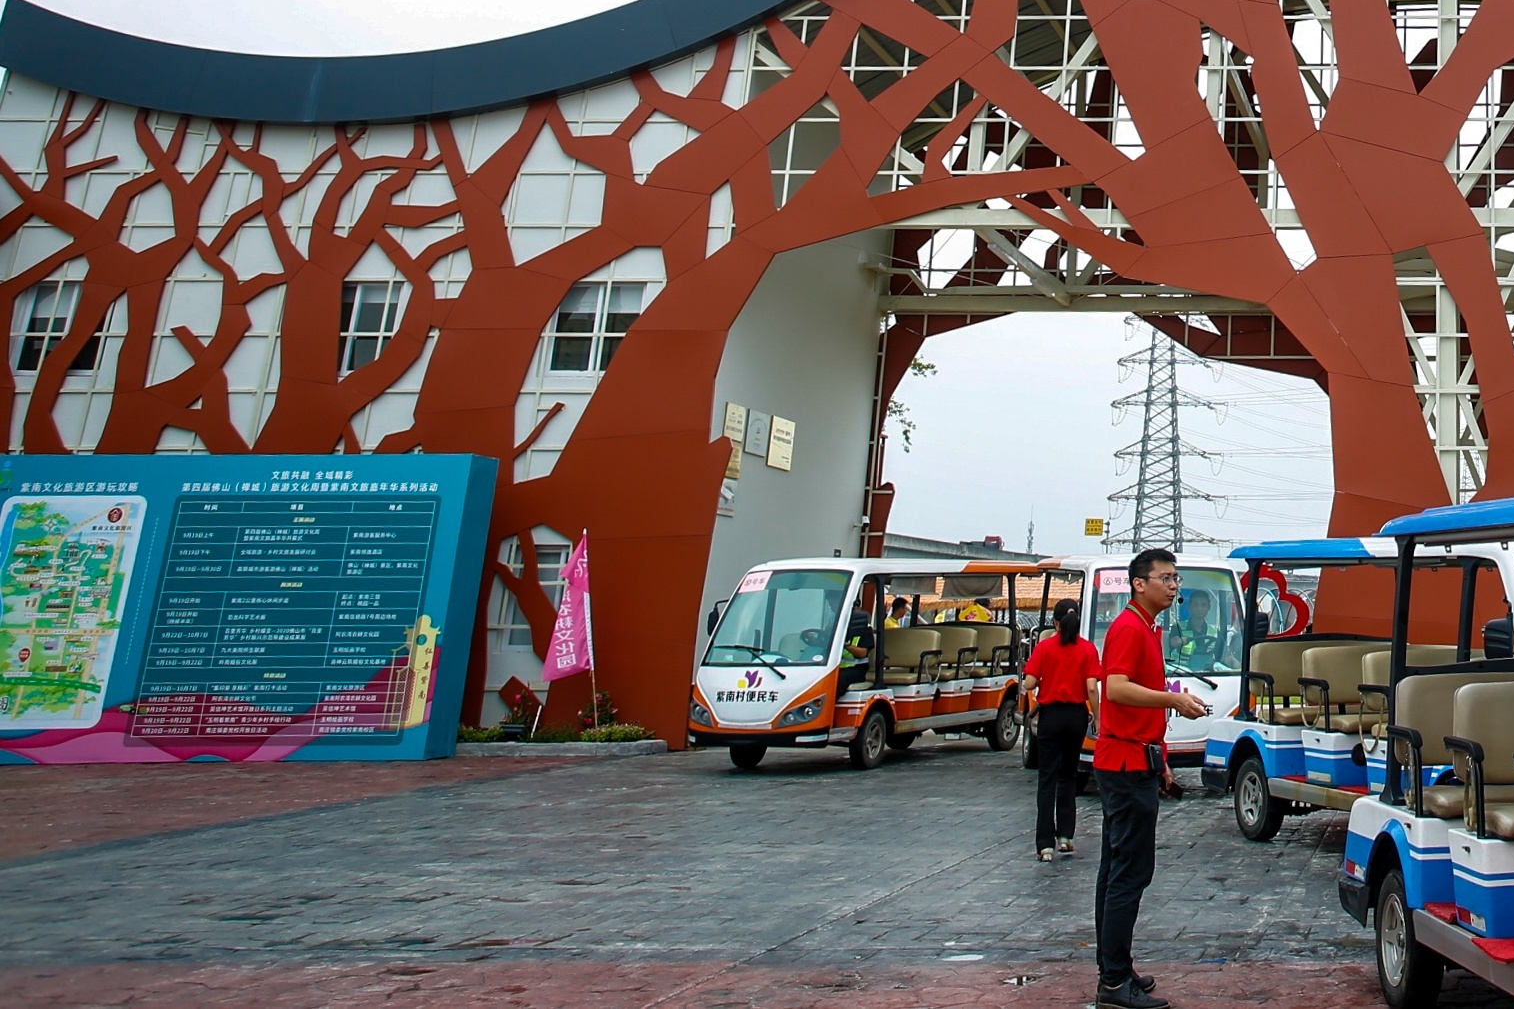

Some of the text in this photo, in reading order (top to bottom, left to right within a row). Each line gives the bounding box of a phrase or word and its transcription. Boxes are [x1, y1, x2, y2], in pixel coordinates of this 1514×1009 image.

[271, 470, 353, 480] 文旅共融 全域精彩
[20, 482, 139, 492] 紫南文化旅游区游玩攻略
[716, 691, 779, 703] 紫南村便民车
